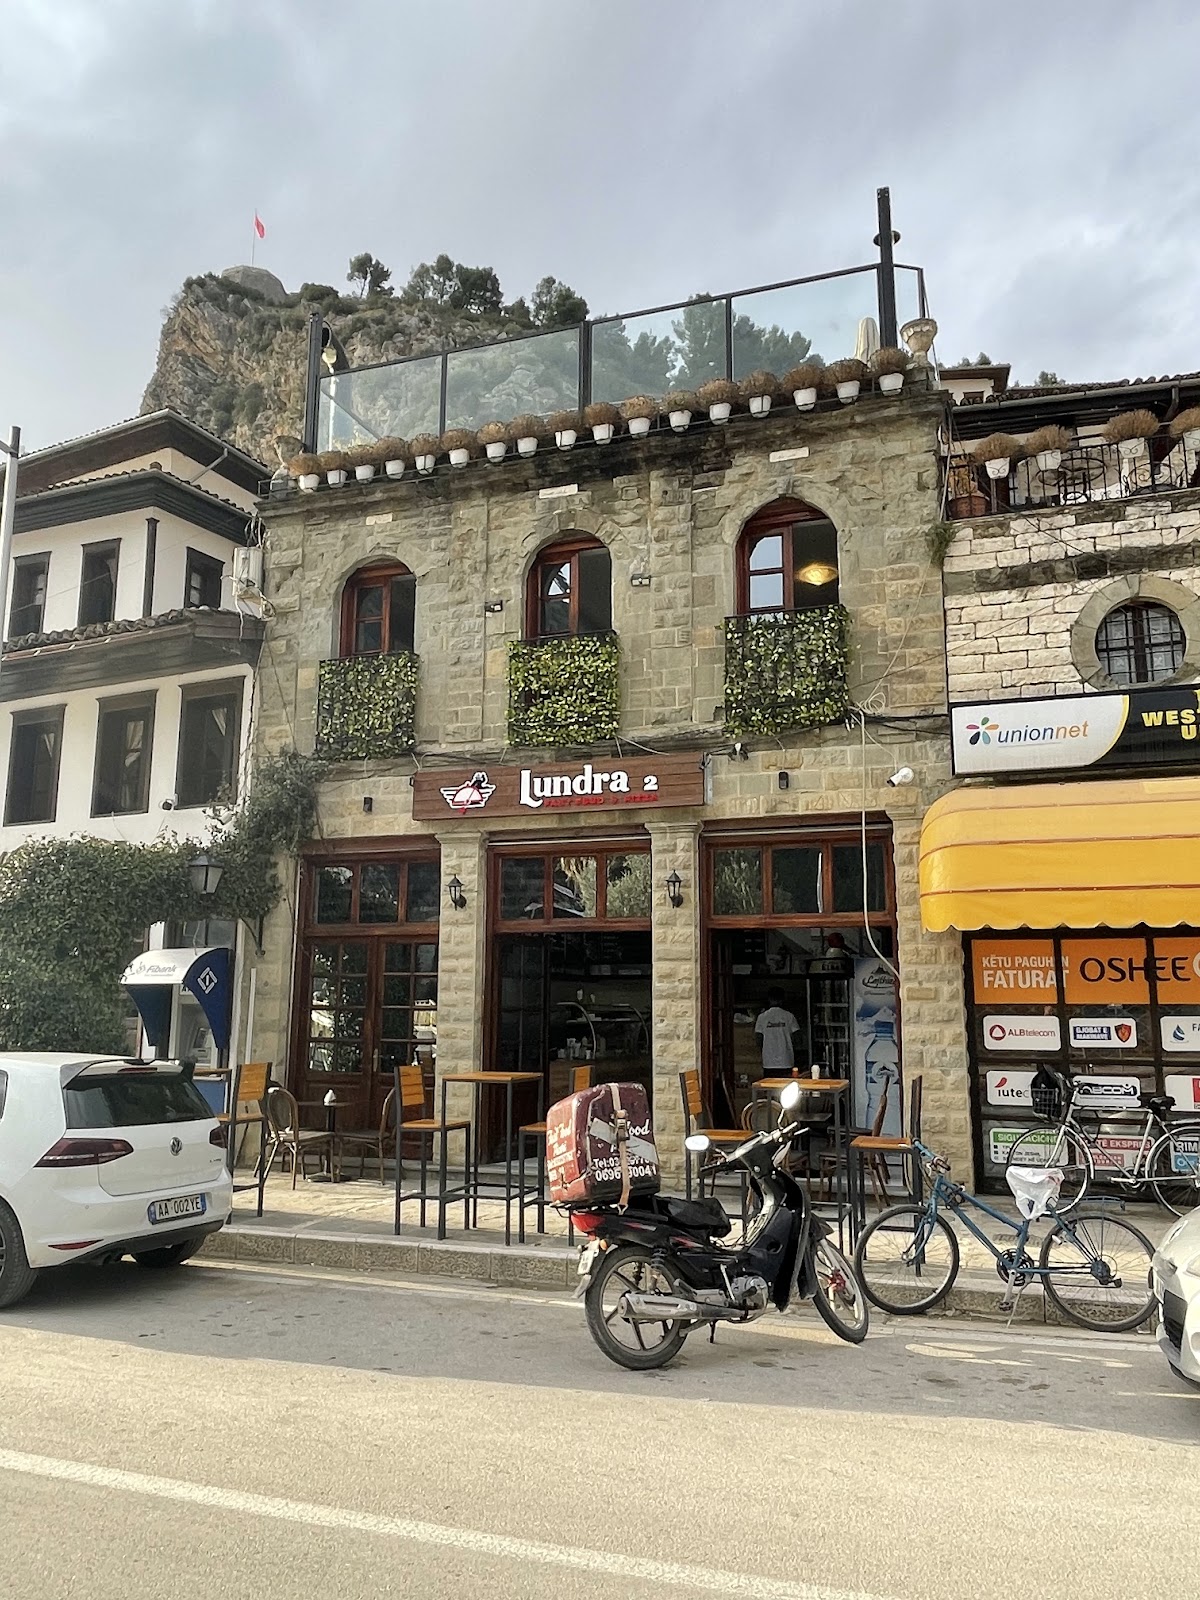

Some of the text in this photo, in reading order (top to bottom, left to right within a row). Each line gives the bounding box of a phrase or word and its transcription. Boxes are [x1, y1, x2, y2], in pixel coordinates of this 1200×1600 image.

[1141, 709, 1200, 727] WES
[997, 720, 1089, 744] unionnet
[1180, 724, 1200, 740] U
[520, 764, 659, 808] Lundra 2
[982, 955, 1069, 968] KËTU PAGUHN
[1079, 956, 1192, 982] OSHEE
[983, 970, 1070, 989] FATURAT
[1008, 1028, 1056, 1038] ALBtelecom
[1110, 1139, 1151, 1150] EKSPRS
[595, 1164, 657, 1182] 06960041
